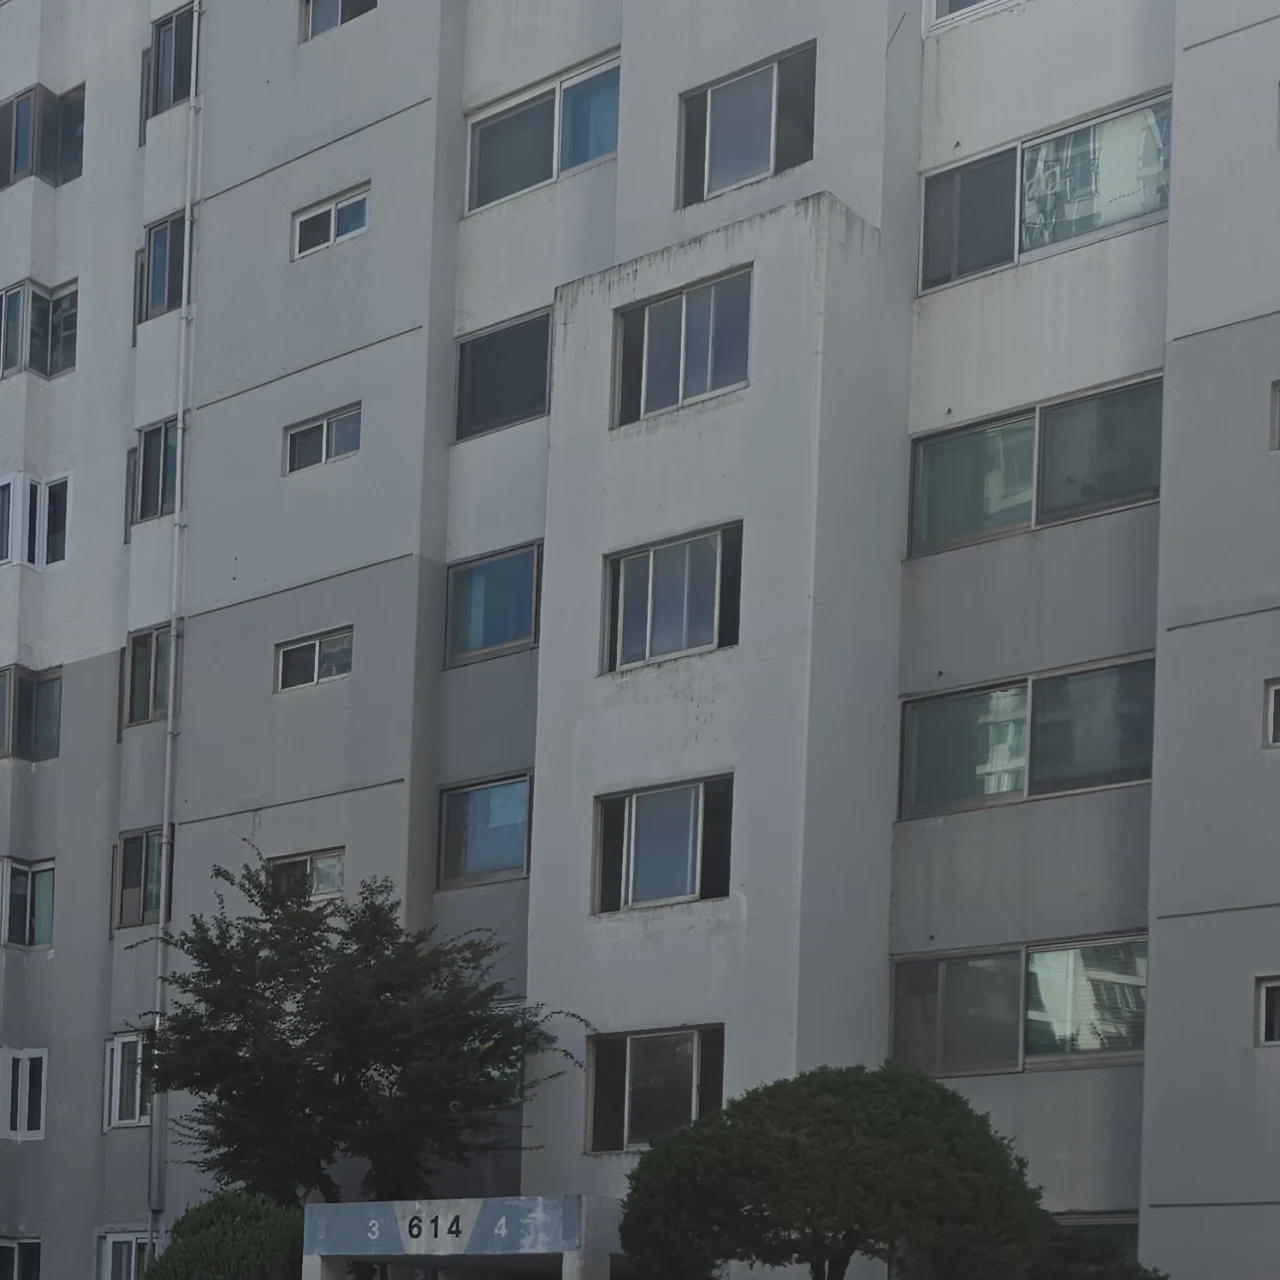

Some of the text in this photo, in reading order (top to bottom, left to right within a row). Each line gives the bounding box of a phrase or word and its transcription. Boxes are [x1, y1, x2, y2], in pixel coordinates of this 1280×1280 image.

[367, 1219, 380, 1240] 3
[408, 1214, 463, 1239] 614
[494, 1216, 508, 1237] 4
